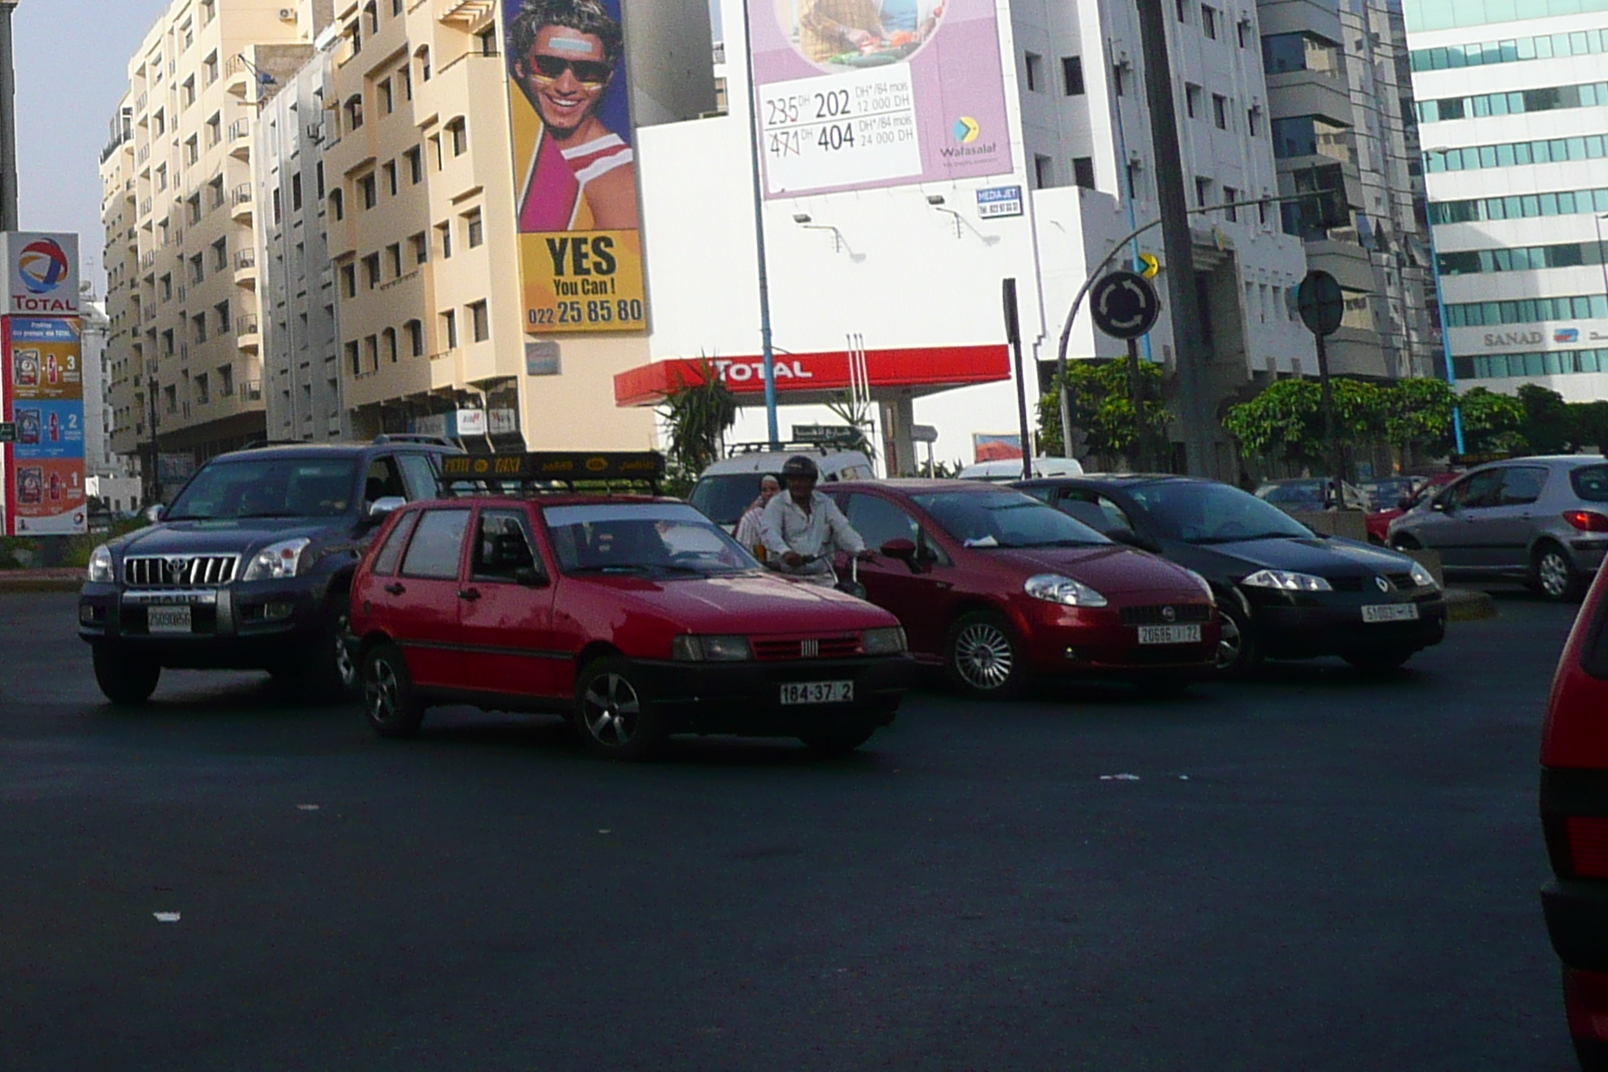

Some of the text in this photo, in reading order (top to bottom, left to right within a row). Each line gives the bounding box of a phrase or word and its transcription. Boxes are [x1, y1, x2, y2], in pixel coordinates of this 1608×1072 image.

[814, 89, 851, 118] 202
[857, 94, 910, 113] 12 000 DH
[817, 122, 855, 152] 404
[860, 128, 914, 147] 24 000 DH
[545, 235, 617, 276] YES
[553, 279, 579, 296] You
[581, 278, 608, 295] Can
[12, 295, 78, 311] TOTAL
[528, 299, 643, 324] 022 25 85 80
[1484, 331, 1543, 347] SANAD
[66, 355, 76, 370] 3
[68, 414, 78, 428] 2
[494, 457, 520, 473] TAXI
[71, 471, 78, 487] 1
[1142, 626, 1172, 642] 20686
